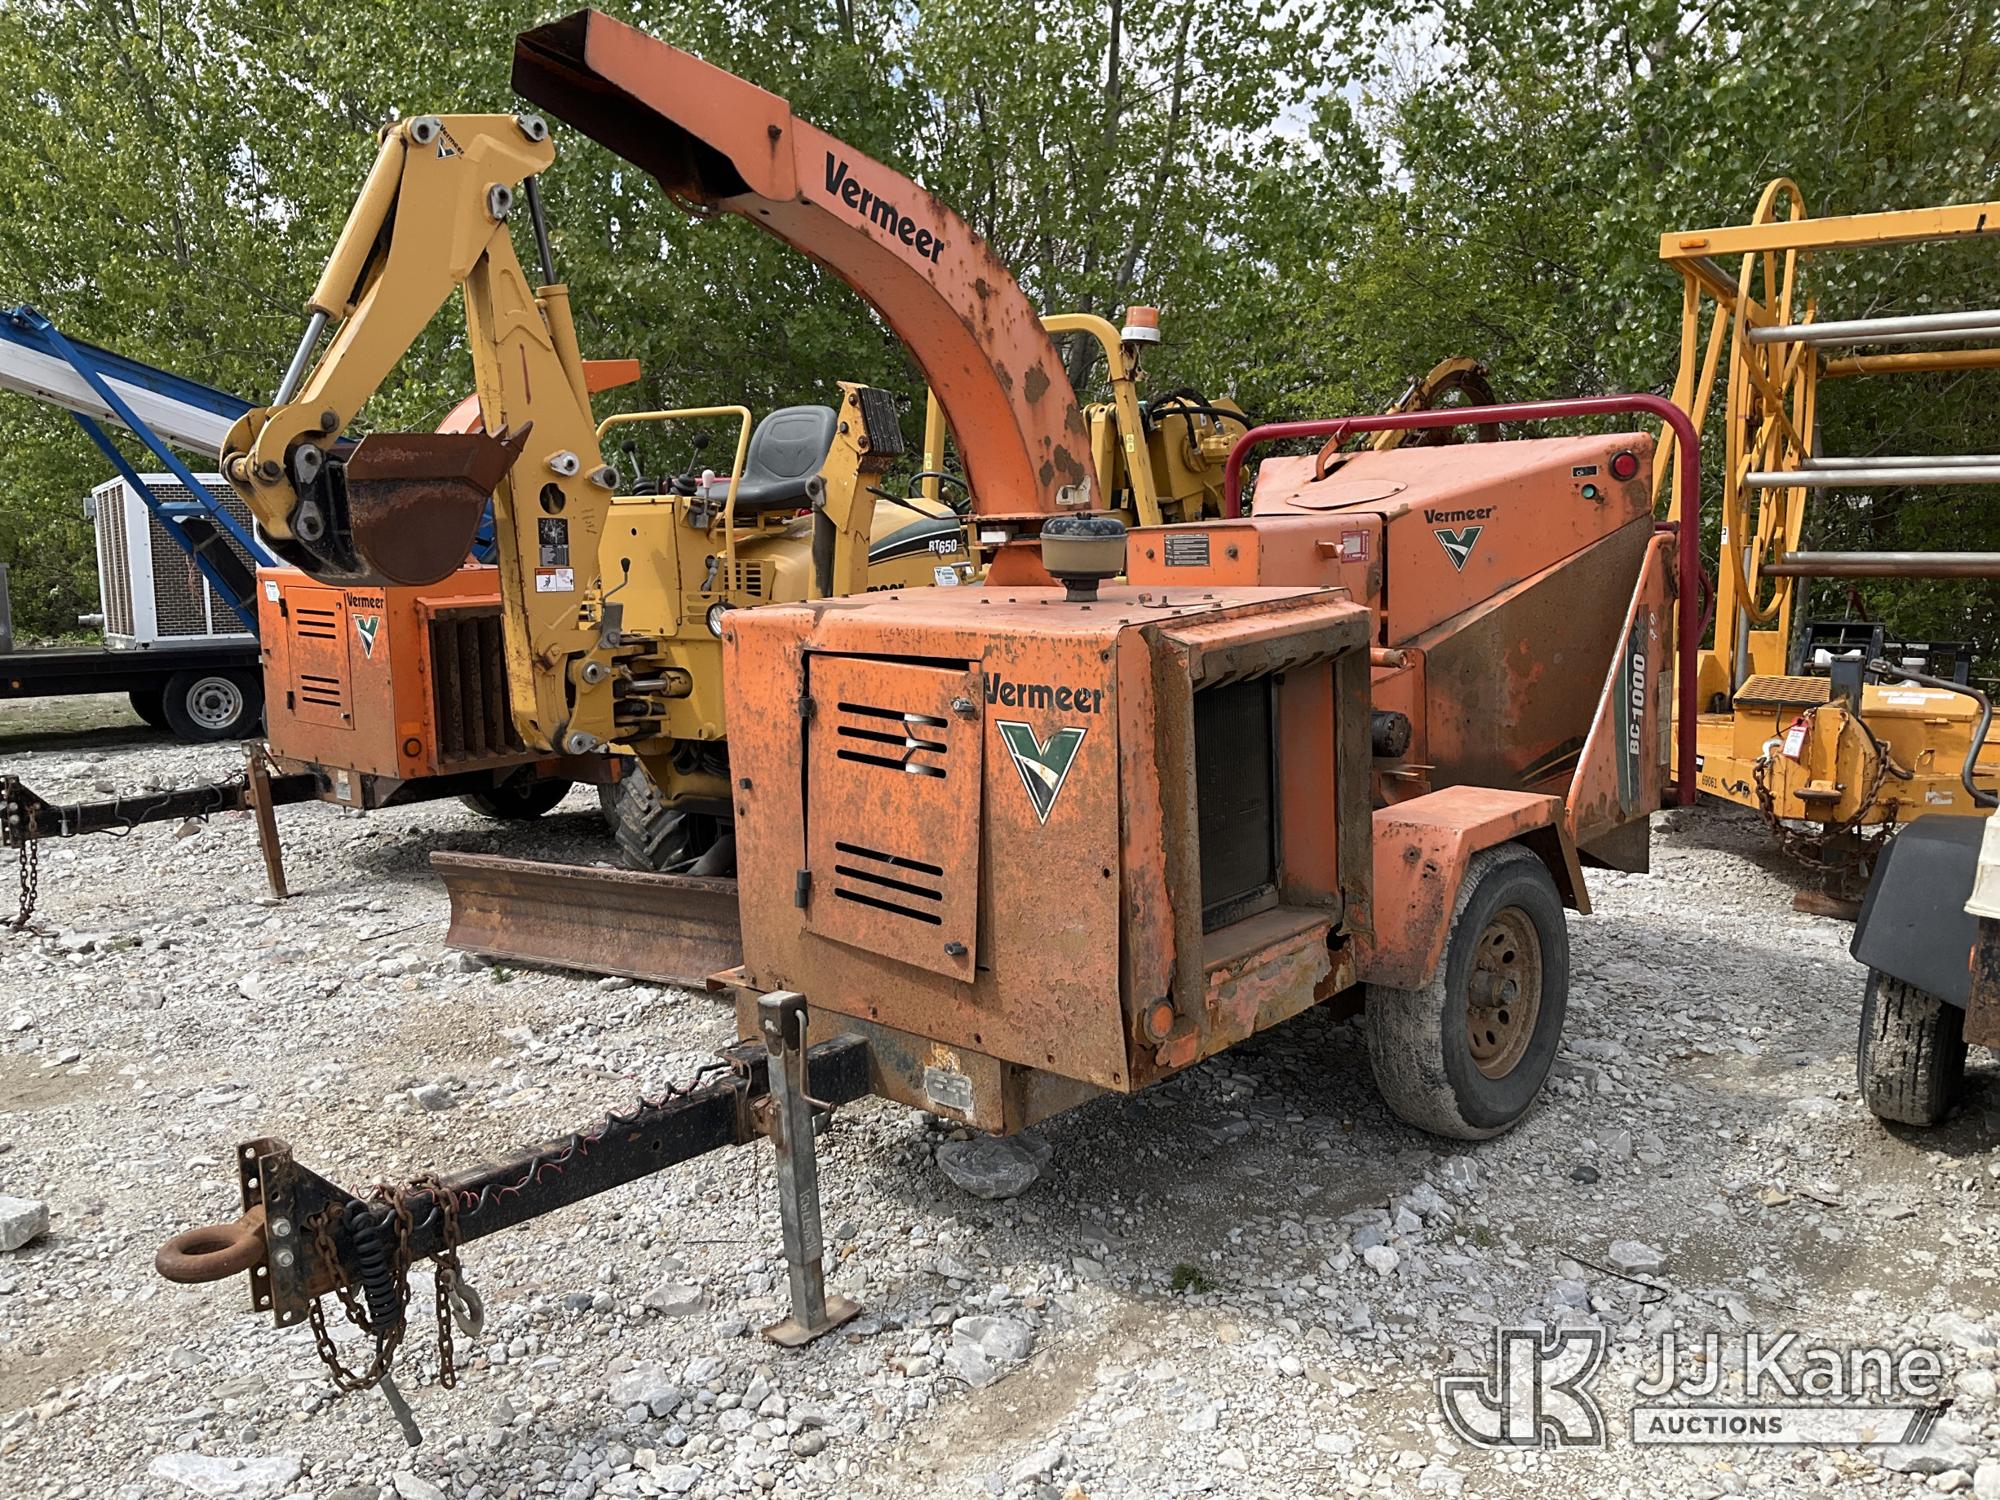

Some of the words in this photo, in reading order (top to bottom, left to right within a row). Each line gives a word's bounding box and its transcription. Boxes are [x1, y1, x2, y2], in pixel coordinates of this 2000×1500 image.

[440, 124, 465, 155] Vermeer
[825, 151, 945, 264] Vermeer
[1424, 507, 1492, 524] Vermeer
[928, 539, 957, 554] RT650
[346, 592, 384, 609] Vermeer
[983, 672, 1104, 714] Vermeer
[1629, 653, 1646, 755] BC1000
